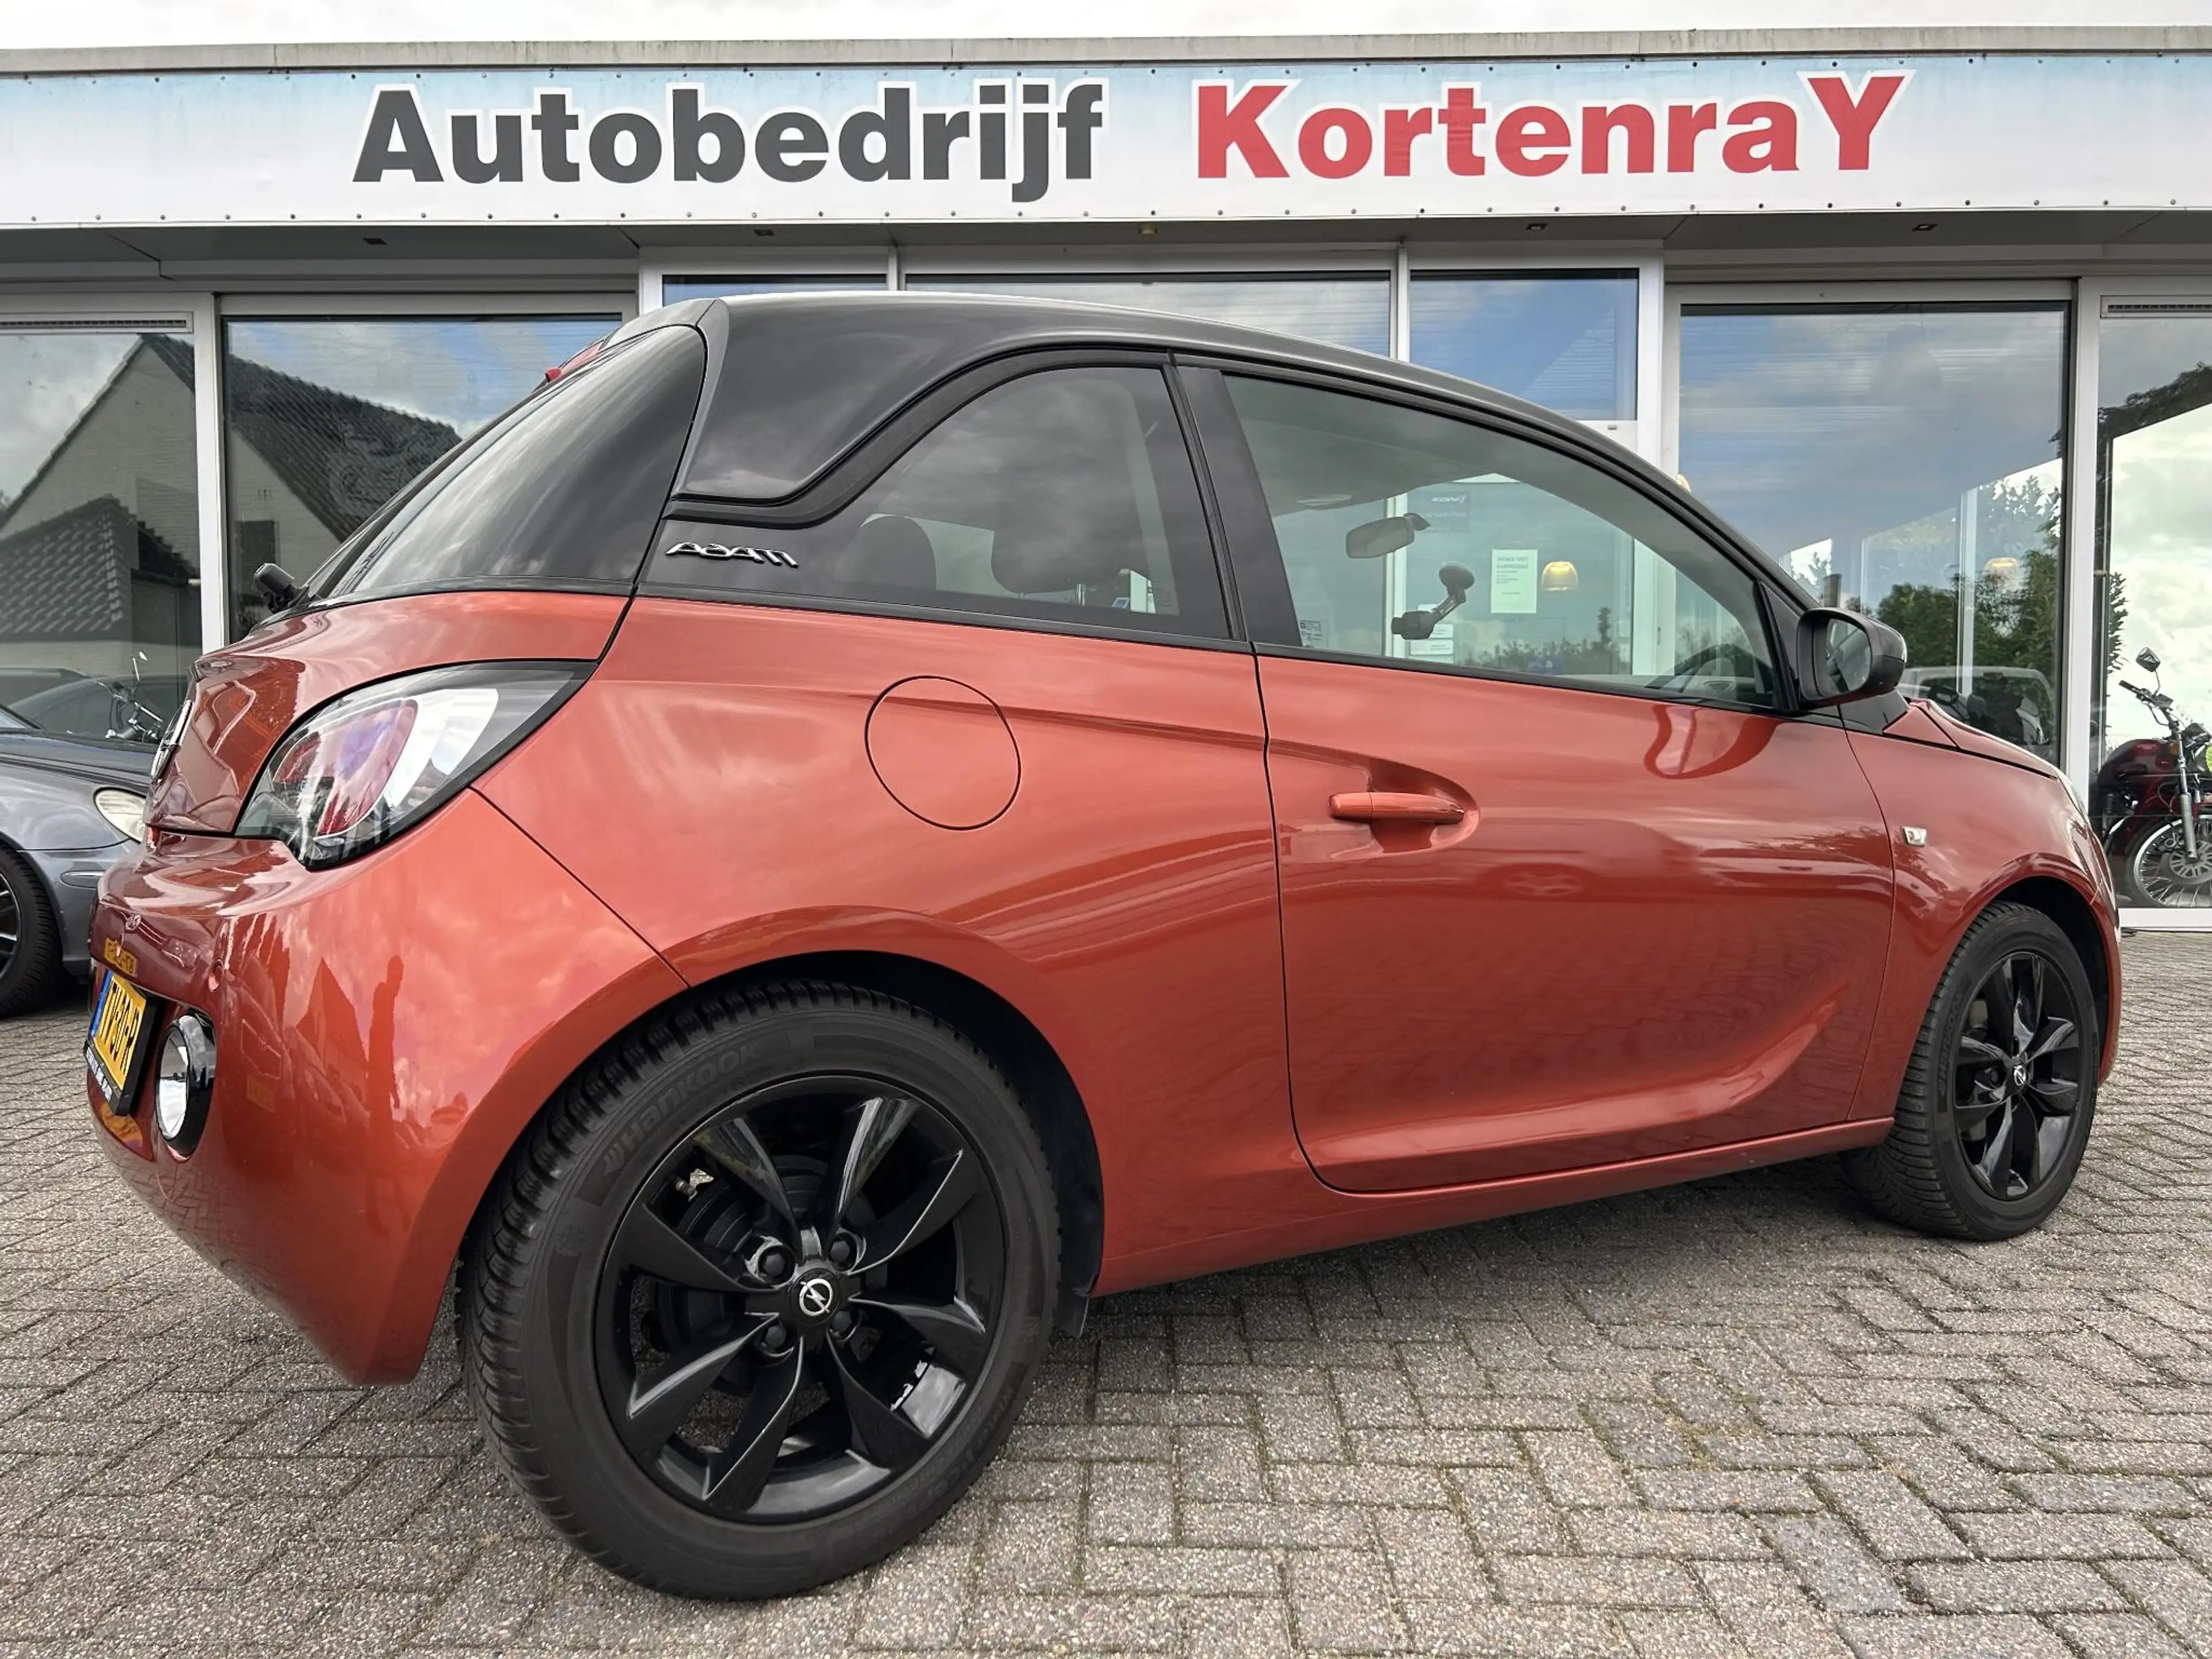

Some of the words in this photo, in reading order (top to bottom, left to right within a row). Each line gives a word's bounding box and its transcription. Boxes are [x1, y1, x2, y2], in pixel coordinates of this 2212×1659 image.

[352, 83, 1103, 203] Autobedrijf
[1196, 75, 1906, 179] KortenraY
[665, 542, 798, 569] ADAM
